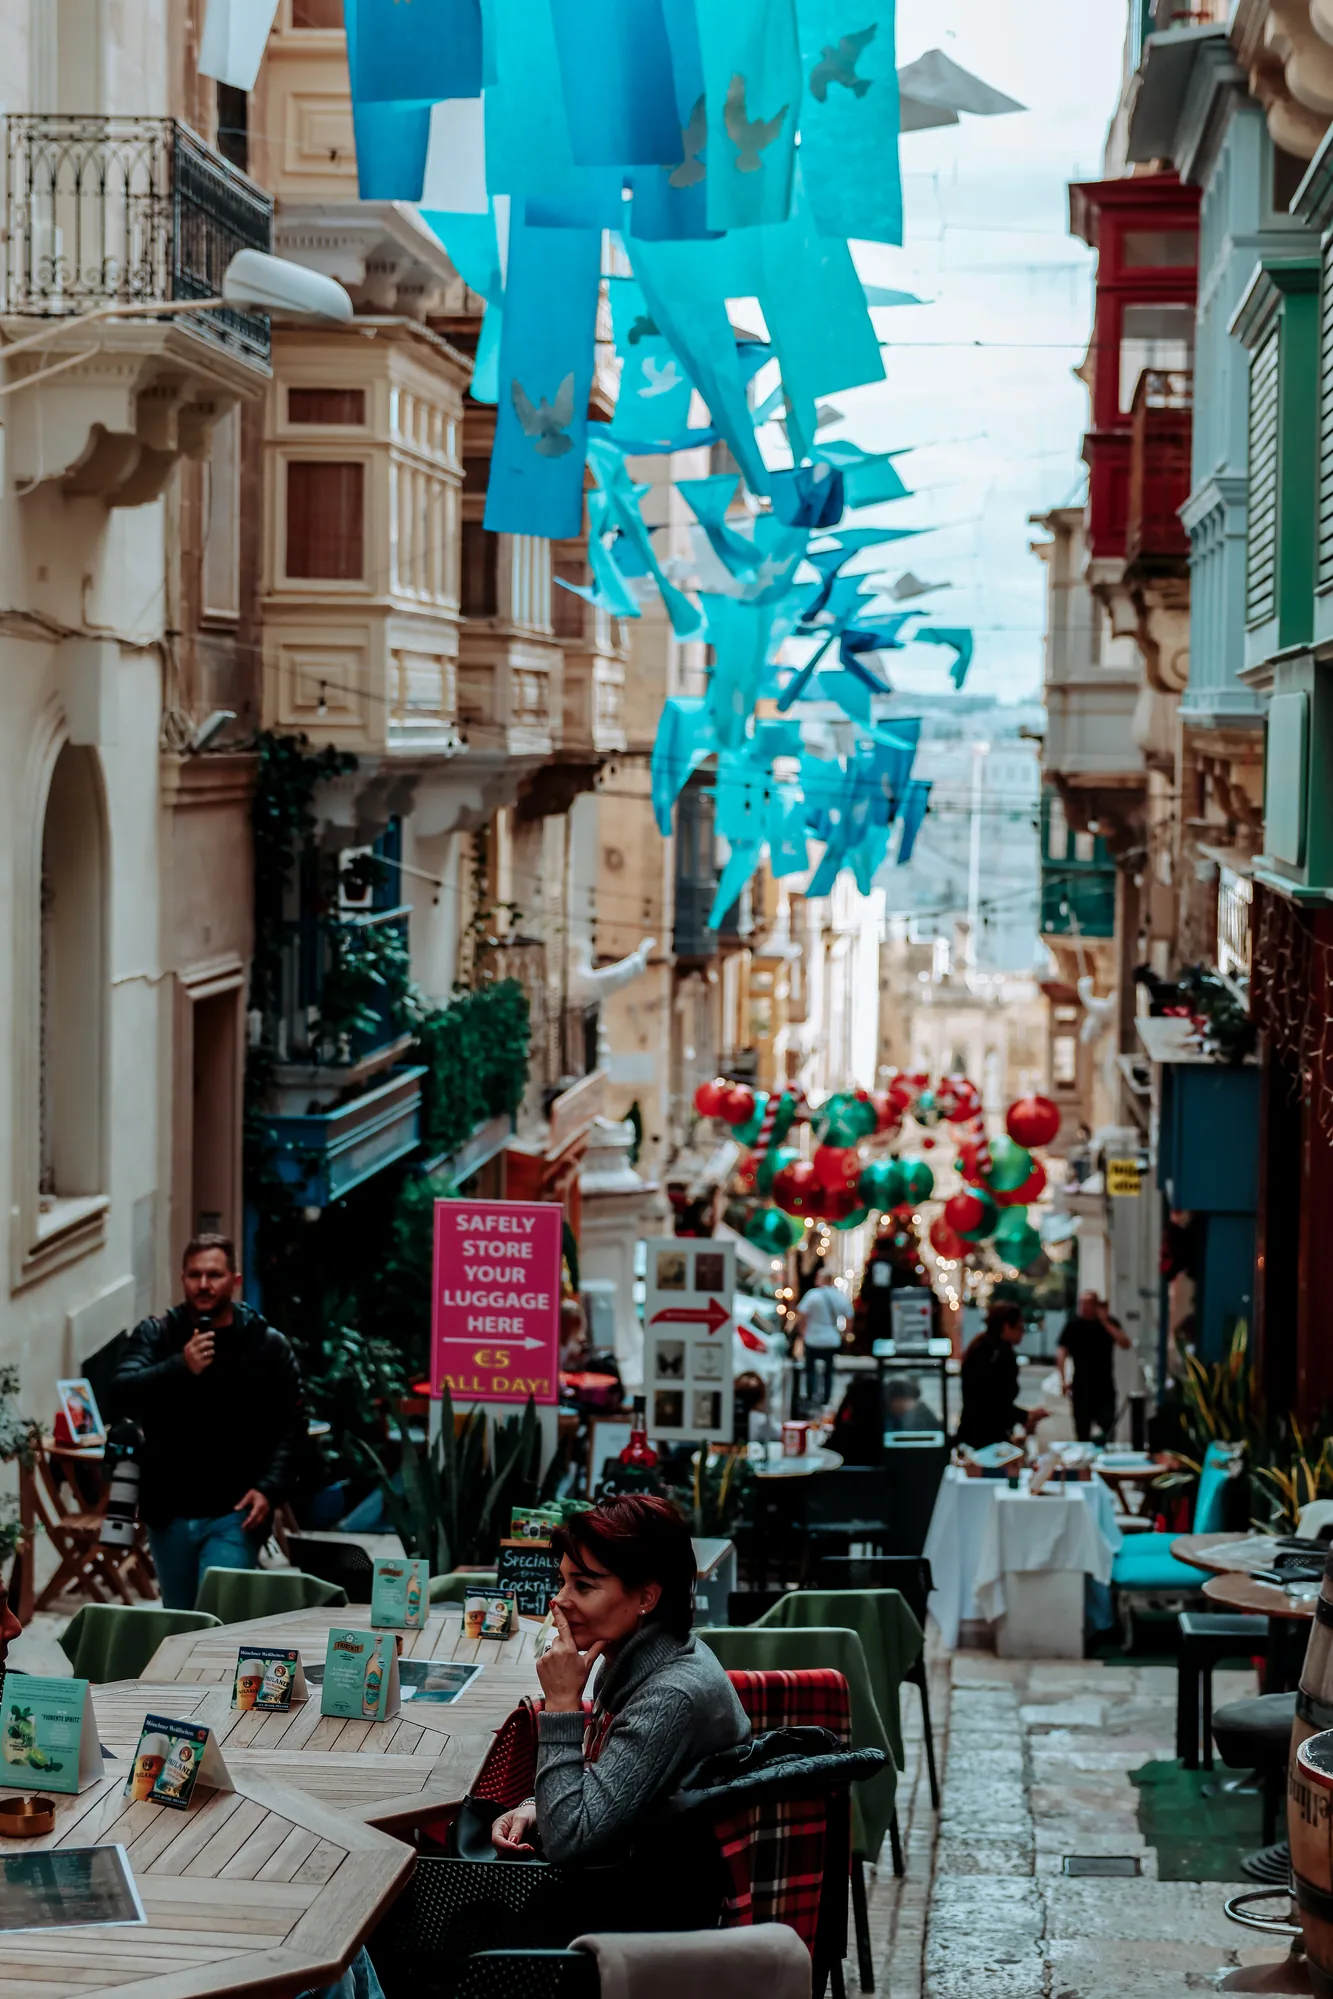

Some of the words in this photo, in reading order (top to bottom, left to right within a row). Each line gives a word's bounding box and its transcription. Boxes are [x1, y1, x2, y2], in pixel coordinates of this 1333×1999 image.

[456, 1214, 536, 1233] SAFELY
[462, 1240, 533, 1259] STORE
[464, 1265, 526, 1284] YOUR
[443, 1290, 550, 1310] LUGGAGE
[467, 1316, 524, 1334] HERE
[473, 1350, 511, 1369] €5
[440, 1375, 485, 1393] ALL
[492, 1377, 550, 1395] DAY!
